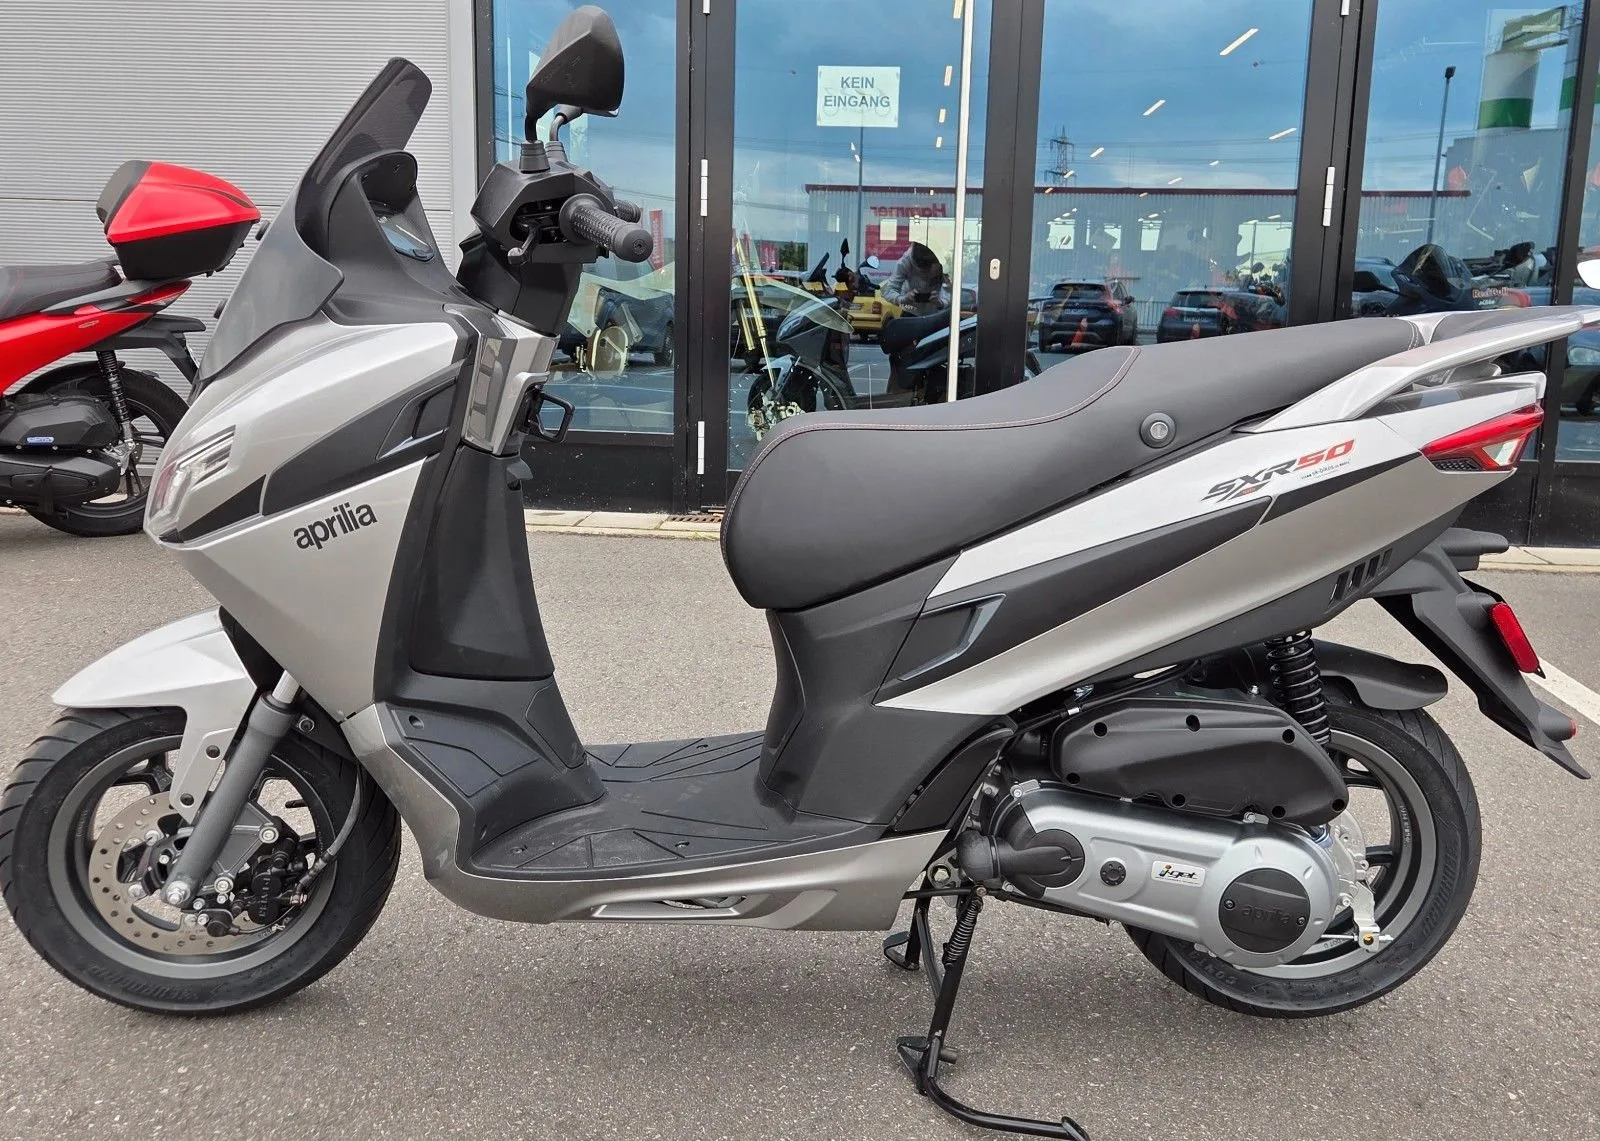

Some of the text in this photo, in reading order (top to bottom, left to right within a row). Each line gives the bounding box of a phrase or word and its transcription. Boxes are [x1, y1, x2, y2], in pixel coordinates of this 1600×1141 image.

[841, 76, 875, 89] KEIN
[824, 95, 891, 108] EINGANG
[293, 501, 378, 550] aprilia
[1242, 904, 1291, 925] aprilia
